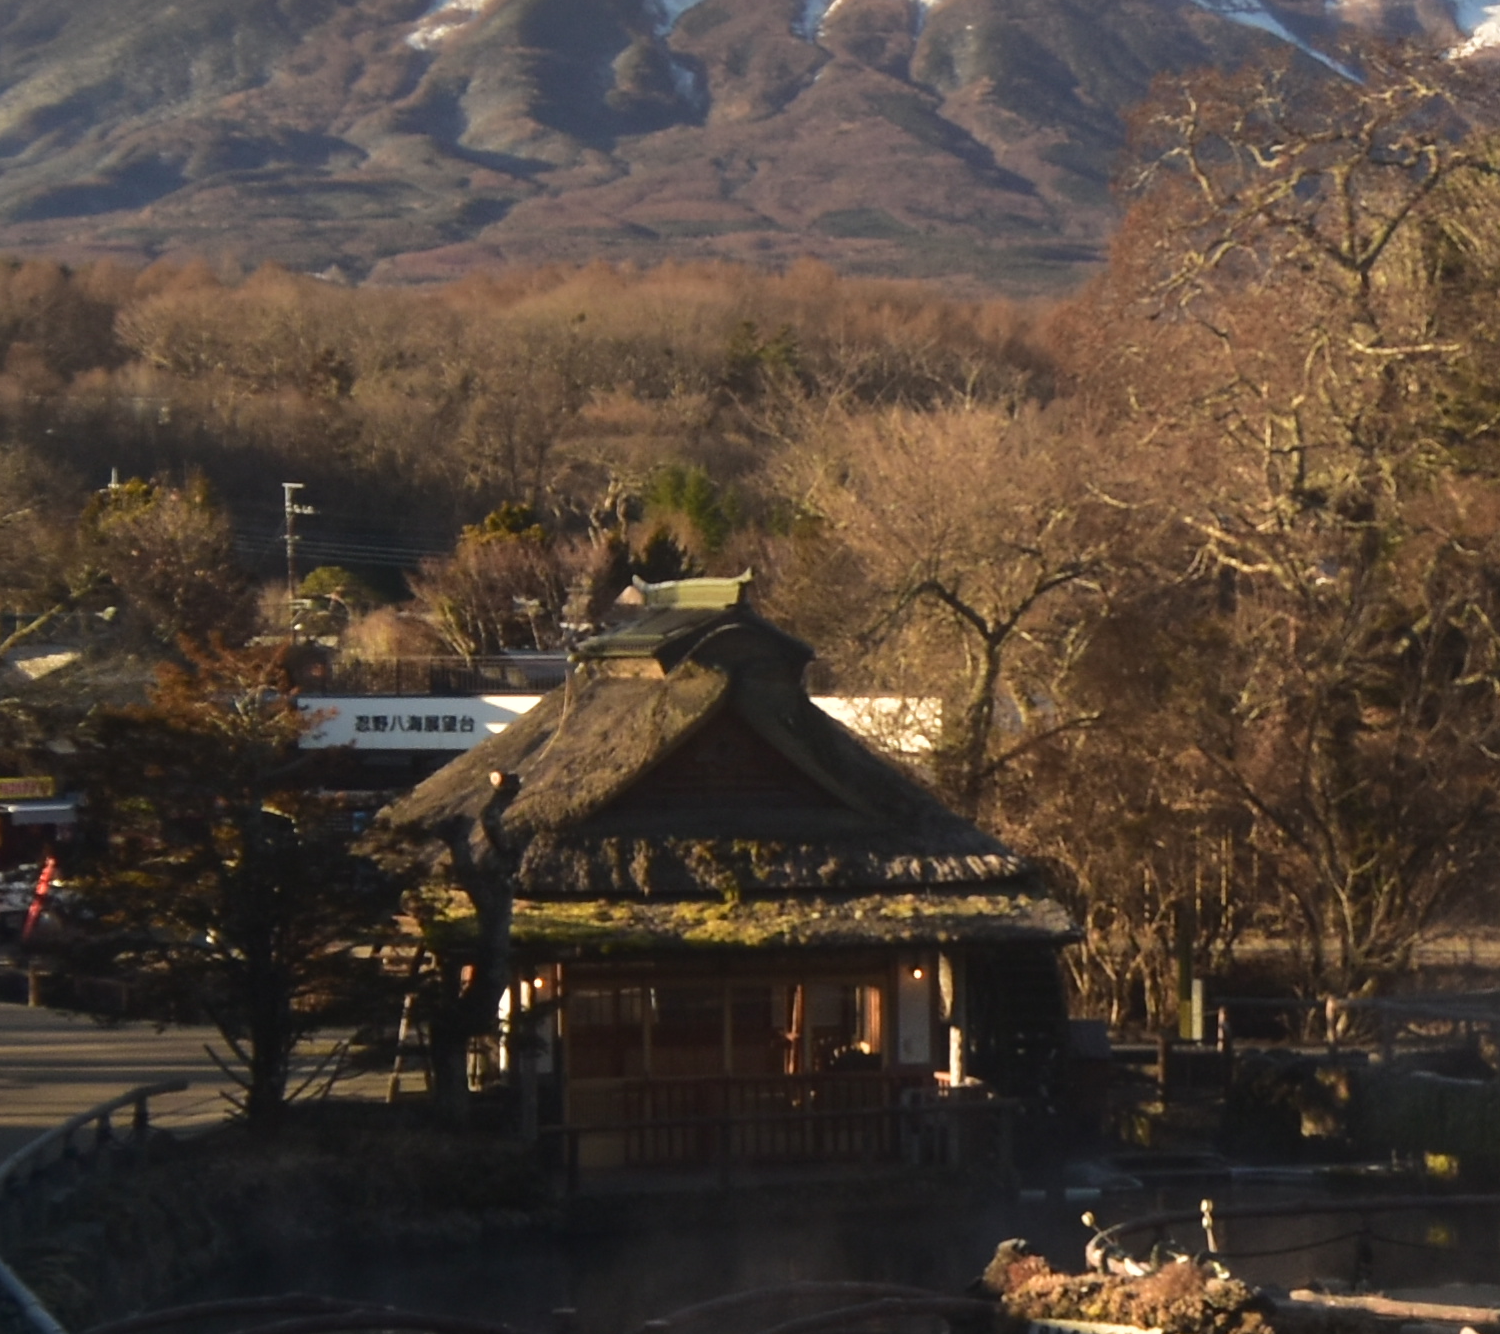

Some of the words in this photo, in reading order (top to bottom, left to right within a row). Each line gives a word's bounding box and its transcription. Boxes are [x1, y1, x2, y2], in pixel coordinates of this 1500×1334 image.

[355, 715, 474, 733] 忍野八海展望台
